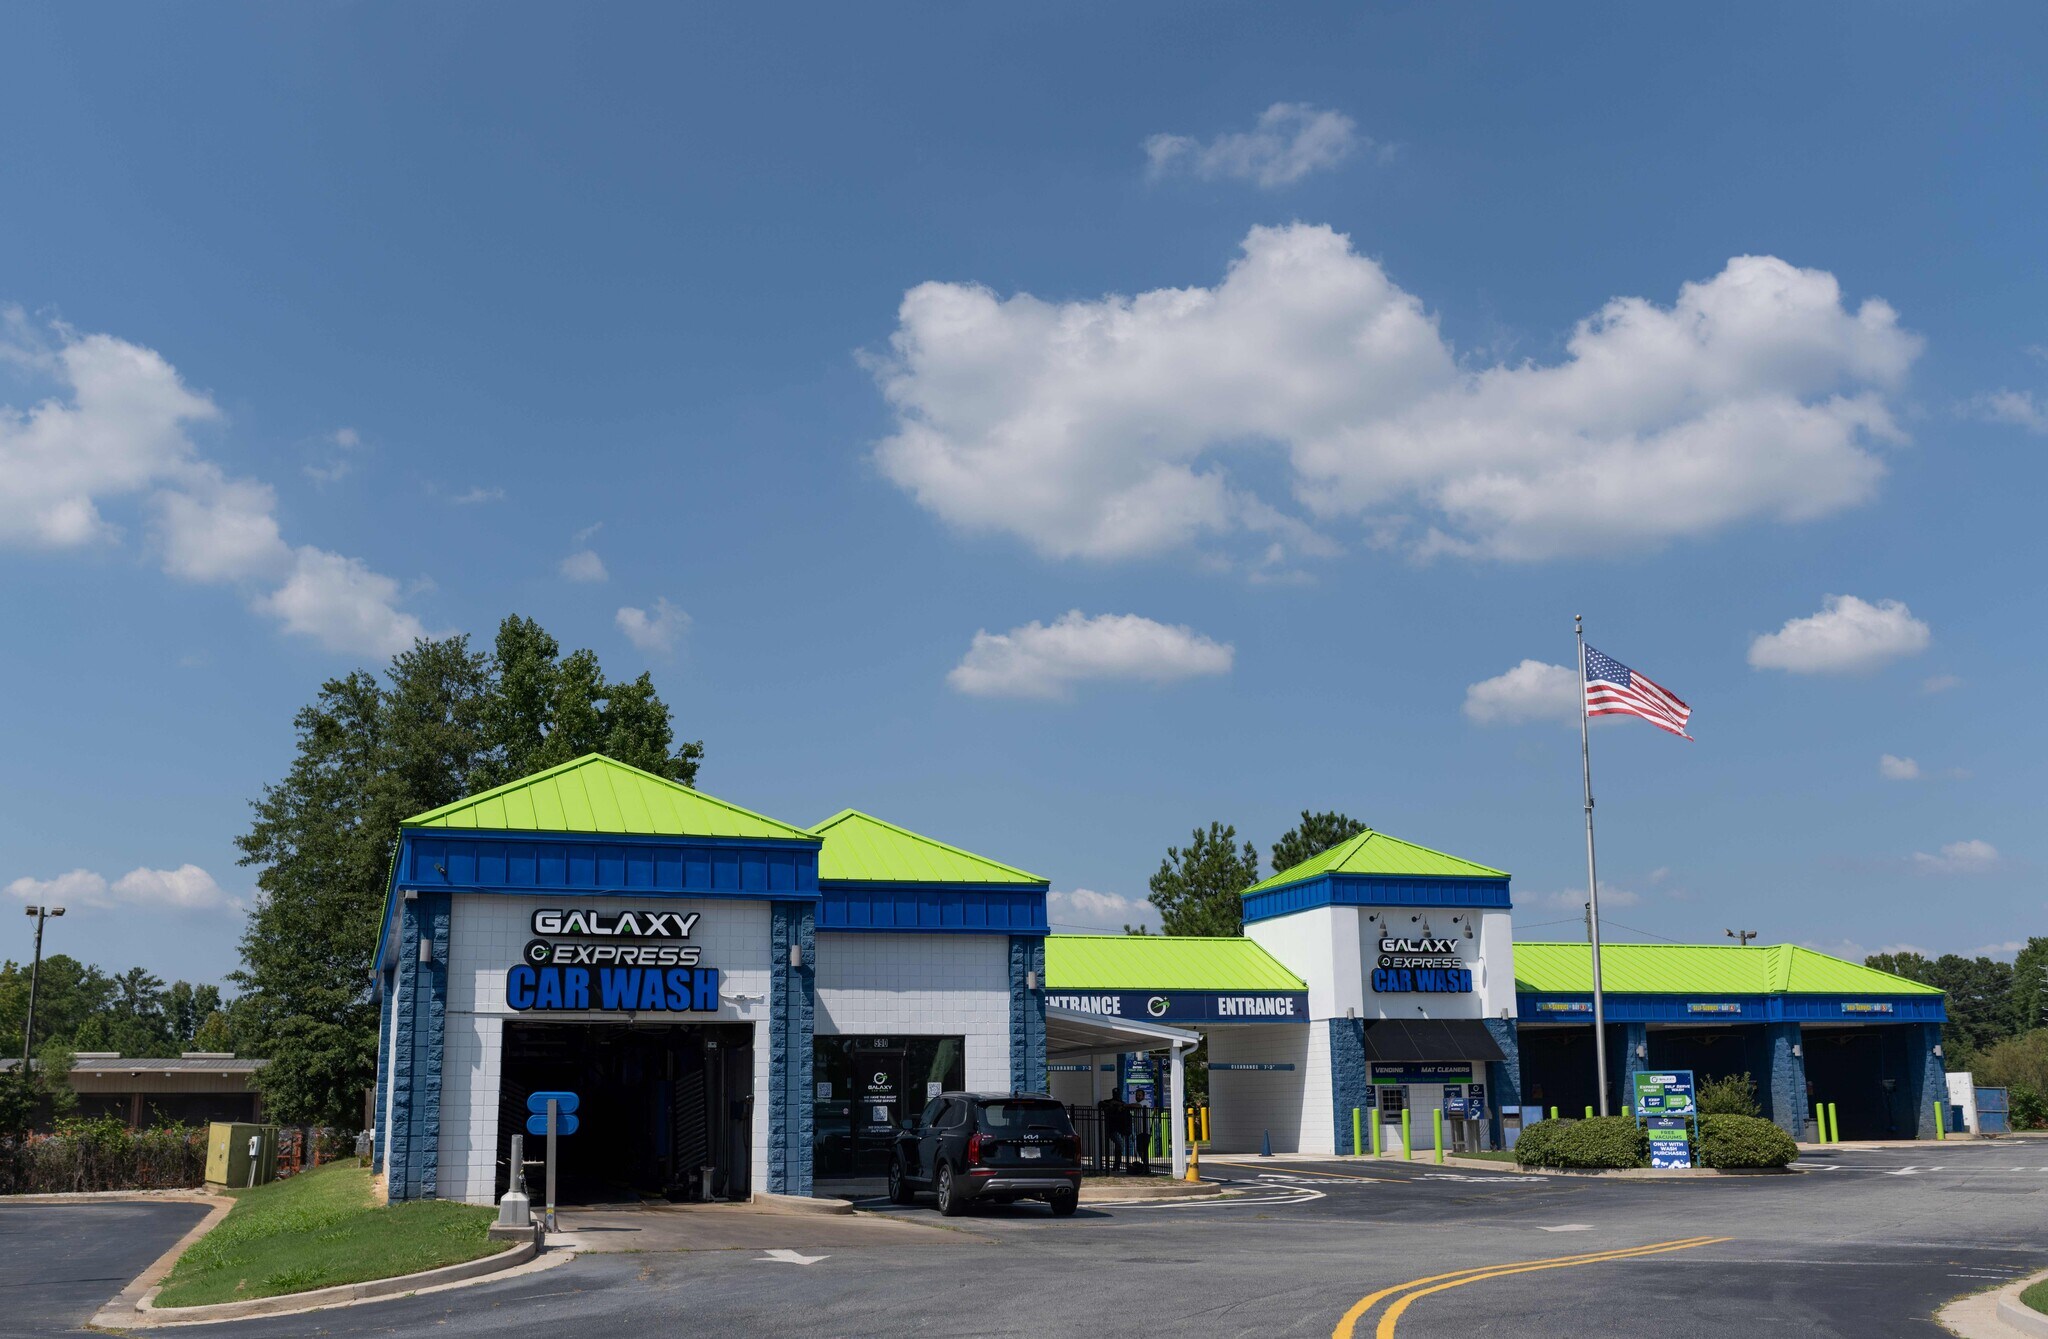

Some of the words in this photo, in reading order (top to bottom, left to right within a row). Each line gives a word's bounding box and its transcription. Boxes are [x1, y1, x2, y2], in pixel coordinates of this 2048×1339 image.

[535, 911, 699, 936] GALAXY
[1382, 939, 1459, 952] GALAXY
[552, 946, 700, 965] EXPRESS
[1393, 957, 1462, 968] EXPRESS
[507, 965, 590, 1010] CAR
[600, 968, 719, 1010] WASH
[1373, 969, 1412, 992] CAR
[1415, 969, 1473, 992] WASH
[1218, 997, 1294, 1016] ENTRANCE
[873, 1039, 889, 1048] 590
